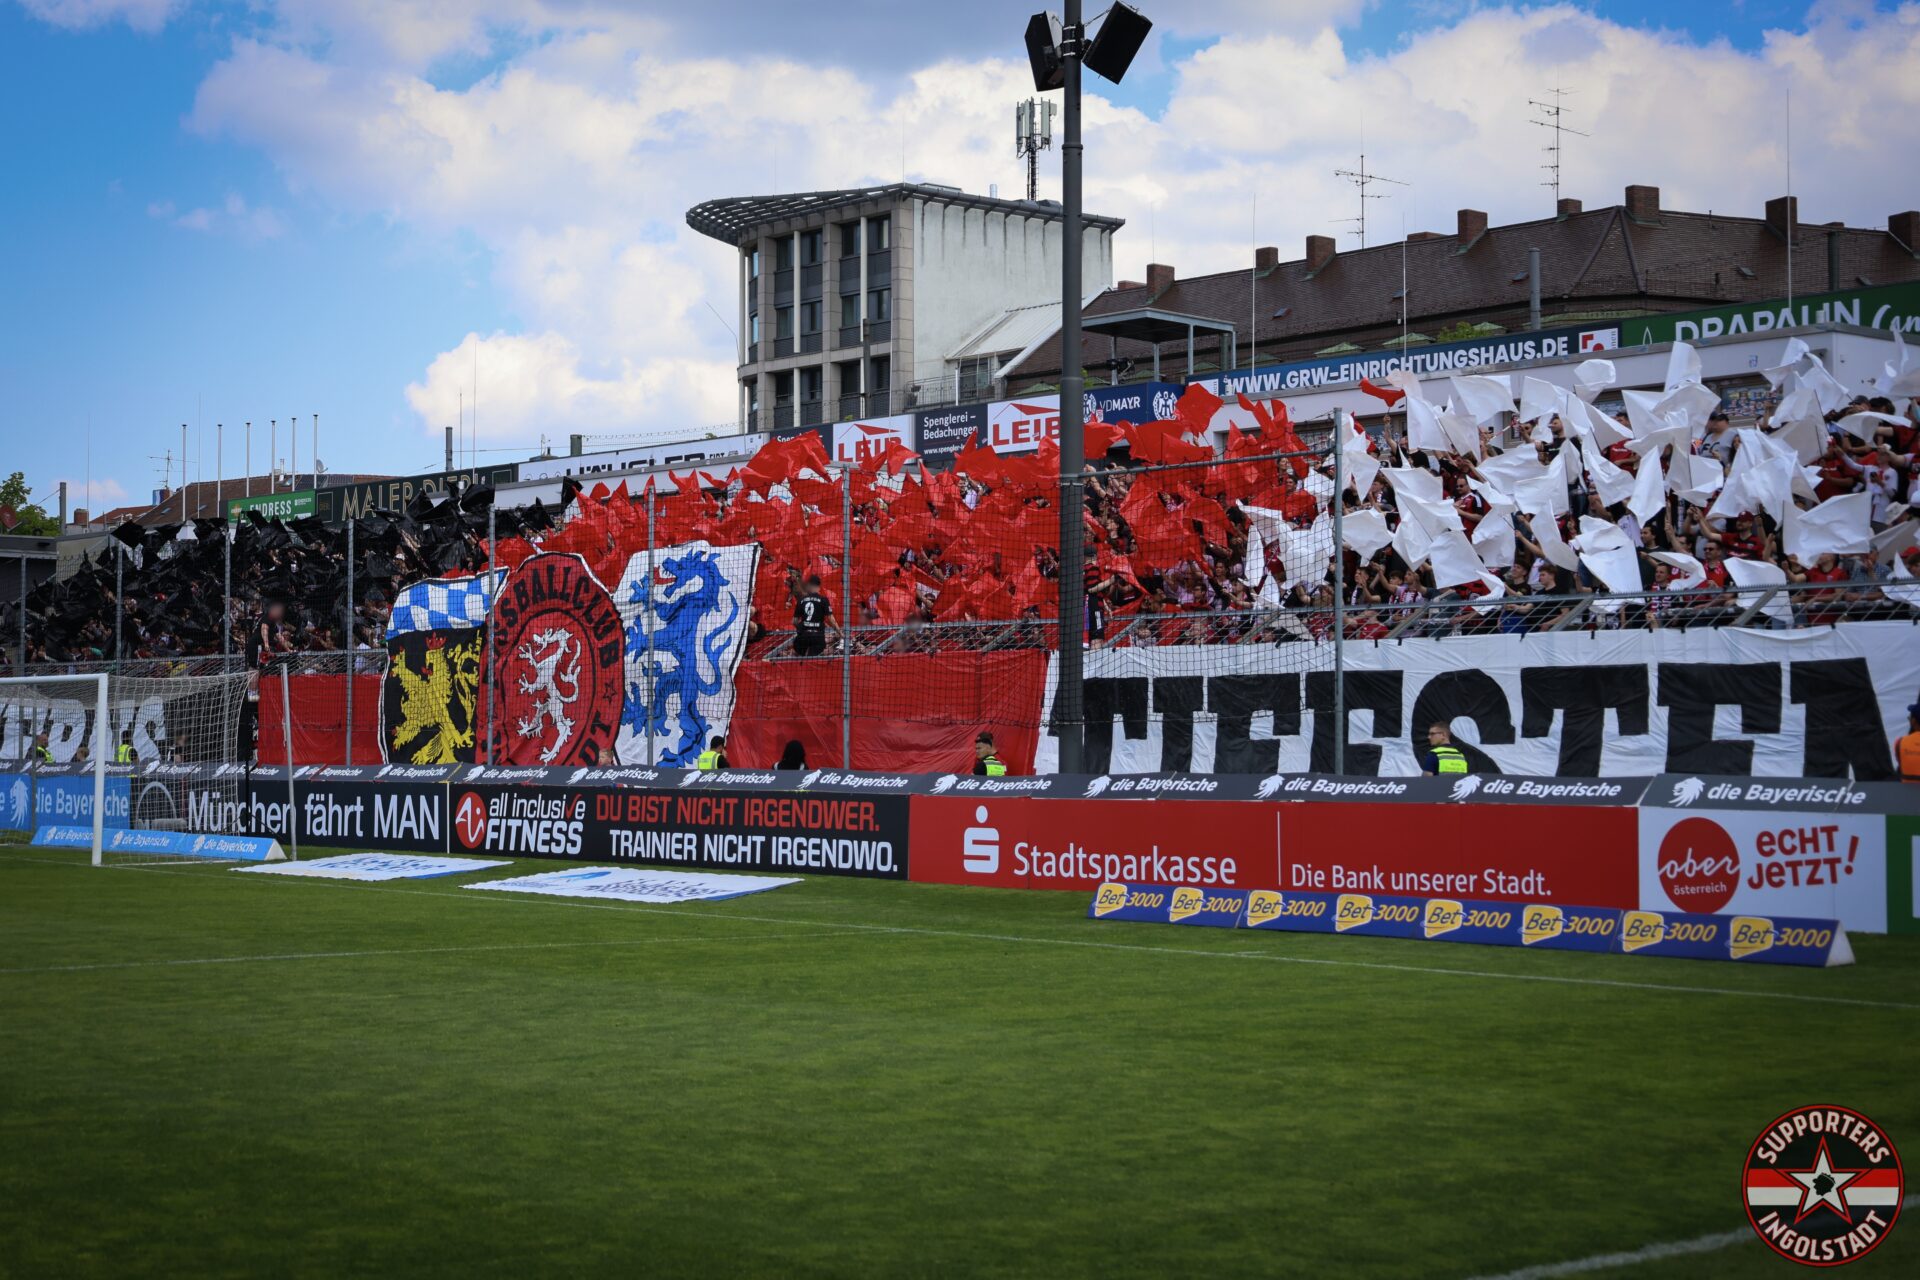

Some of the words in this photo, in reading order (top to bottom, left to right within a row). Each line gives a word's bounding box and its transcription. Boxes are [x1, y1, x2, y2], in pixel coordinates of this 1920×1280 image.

[1226, 337, 1568, 396] WWW.GRW-EINRICHTUNGSHAUS.DE
[923, 411, 969, 428] Spenglerei
[804, 601, 815, 621] 9
[388, 766, 403, 776] die
[403, 766, 447, 778] Bayerische
[482, 768, 497, 779] die
[497, 767, 549, 780] Bayerische
[585, 769, 601, 780] die
[601, 768, 659, 781] Bayerische
[699, 771, 715, 782] die
[716, 771, 776, 785] Bayerische
[819, 773, 839, 785] die
[840, 773, 909, 788] Bayerische
[957, 779, 979, 790] die
[979, 779, 1052, 793] Bayerische
[1110, 778, 1135, 792] die
[1135, 777, 1219, 793] Bayerische
[1284, 777, 1310, 791] die
[1310, 778, 1407, 796] Bayerische
[1482, 779, 1514, 794] die
[1515, 780, 1622, 798] Bayerische
[1707, 783, 1741, 801] die
[1744, 784, 1867, 805] Bayerische
[55, 788, 129, 820] Bayerche
[489, 792, 508, 818] all
[511, 793, 586, 820] inclusive
[596, 794, 622, 822] DU
[627, 795, 672, 824] BIST
[676, 796, 739, 827] NICHT
[743, 798, 880, 832] IRGENDWER.
[304, 792, 364, 838] fährt
[373, 793, 440, 840] MAN
[203, 837, 216, 850] die
[216, 838, 258, 853] Bayerische
[485, 818, 584, 855] FITNESS
[609, 829, 698, 861] TRAINIER
[703, 833, 766, 864] NICHT
[771, 835, 898, 872] IRGENDWO.
[1013, 842, 1237, 885] Stadtsparkasse
[1657, 847, 1741, 880] ober
[1291, 863, 1325, 888] Die
[1331, 865, 1385, 890] Bank
[1391, 871, 1478, 893] unserer
[1483, 868, 1552, 897] Stadt.
[1673, 882, 1727, 896] österreich
